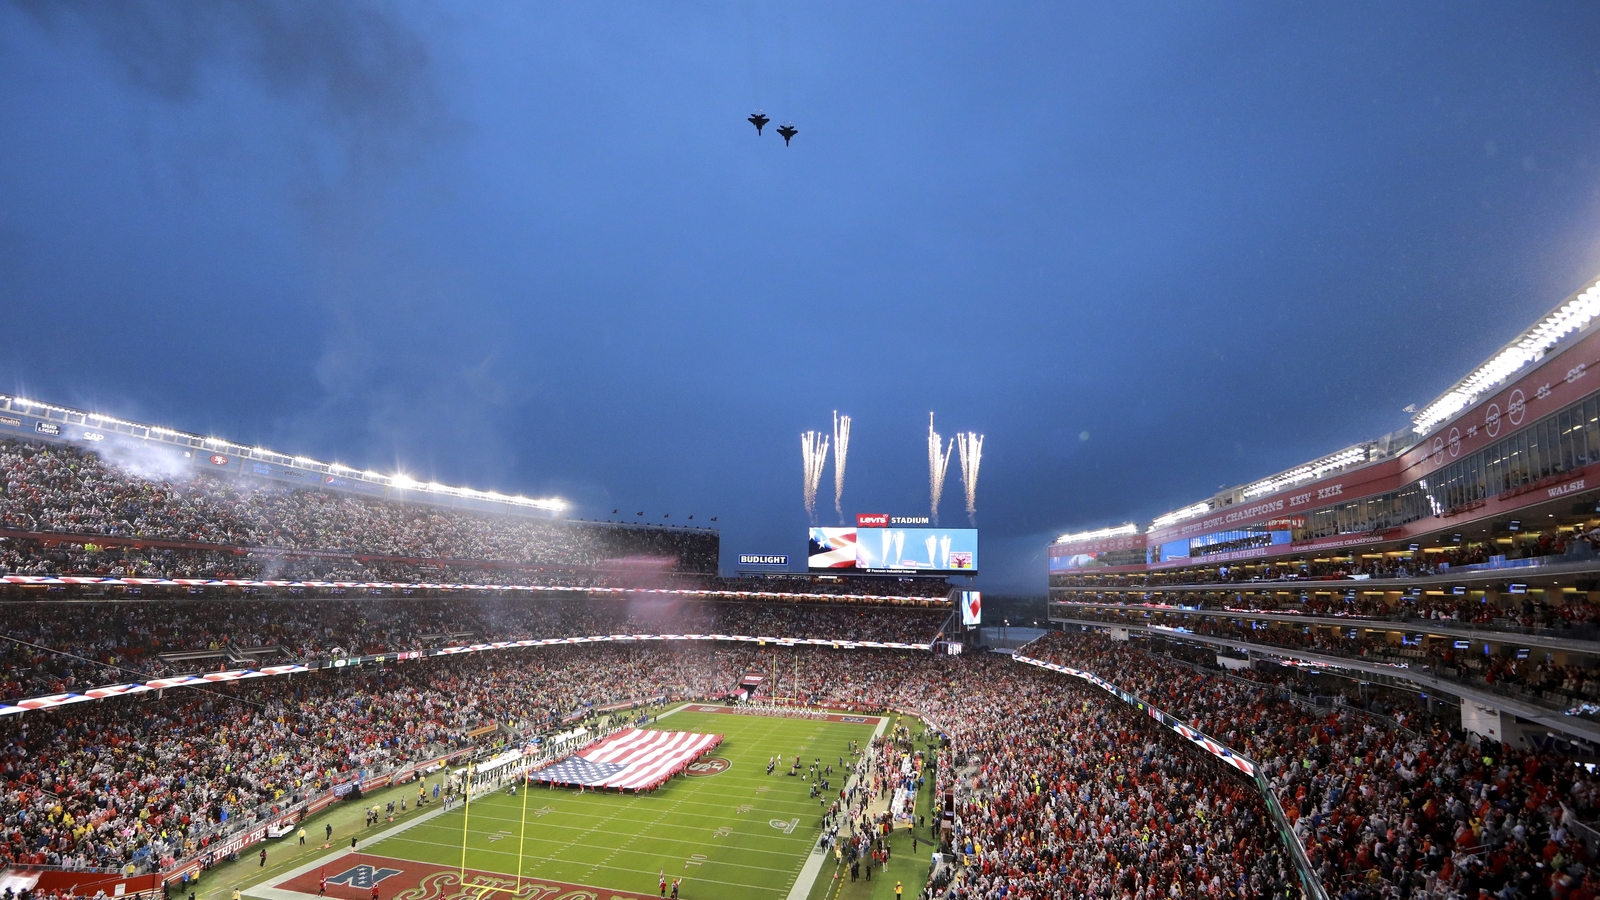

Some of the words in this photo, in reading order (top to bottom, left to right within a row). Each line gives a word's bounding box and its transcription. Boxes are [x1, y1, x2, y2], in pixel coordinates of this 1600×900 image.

[38, 426, 60, 435] LIGHT
[83, 431, 104, 442] SAP
[1547, 479, 1585, 497] WALSH
[1181, 522, 1203, 535] SUPER
[1203, 516, 1225, 529] BOWL
[1226, 499, 1284, 523] CHAMPIONS
[1289, 492, 1311, 507] XXIV
[1317, 483, 1343, 500] XXIX
[1309, 540, 1344, 550] CONFERENCE
[1344, 535, 1384, 546] CHAMPIONS
[1191, 556, 1207, 564] HOME
[1207, 554, 1216, 562] OF
[1216, 552, 1229, 561] THE
[1231, 548, 1267, 559] FAITHFUL
[250, 828, 266, 843] THE
